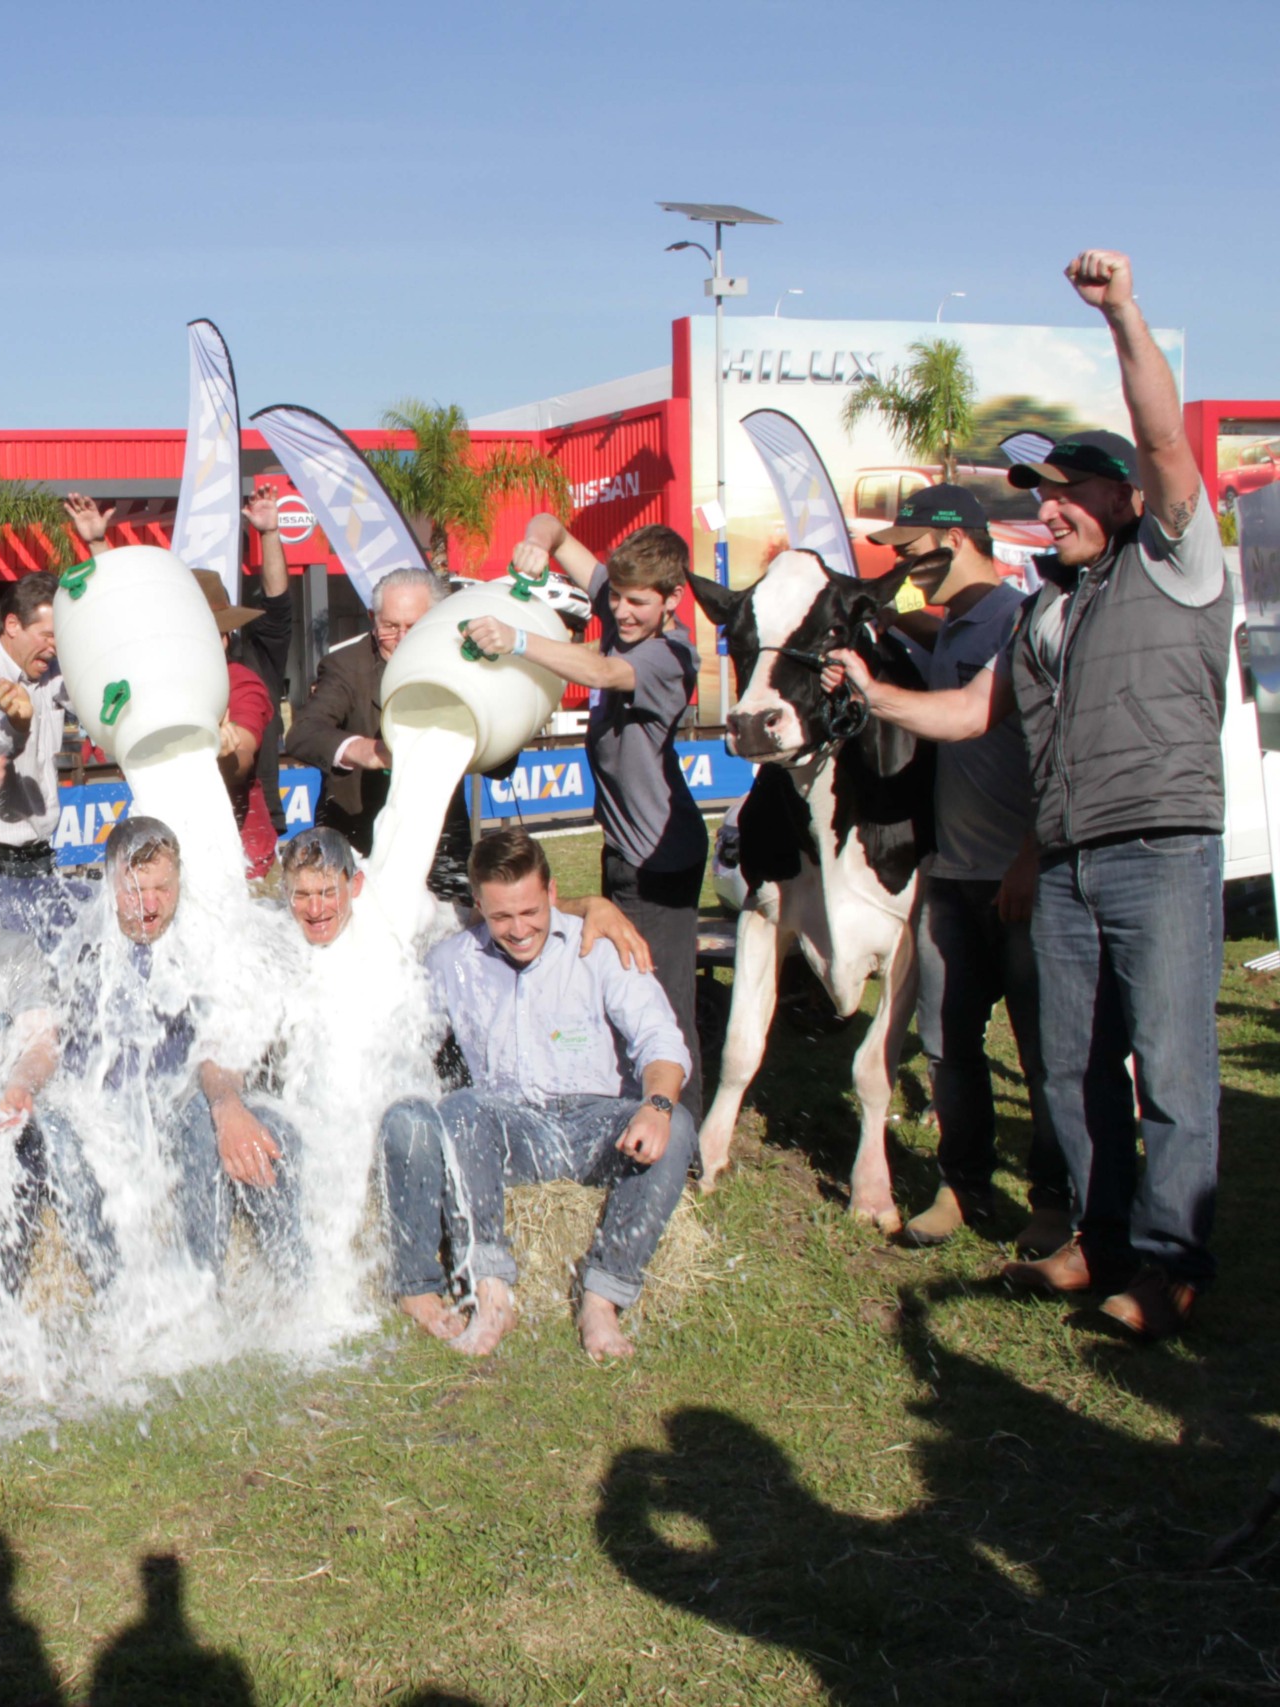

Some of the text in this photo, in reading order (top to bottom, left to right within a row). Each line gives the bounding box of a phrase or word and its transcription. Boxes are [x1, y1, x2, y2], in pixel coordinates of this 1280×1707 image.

[721, 349, 885, 385] HILUX
[568, 471, 639, 509] NISSAN
[279, 515, 314, 524] ISSAN
[490, 762, 583, 803] CAIXA
[51, 800, 126, 849] AIX
